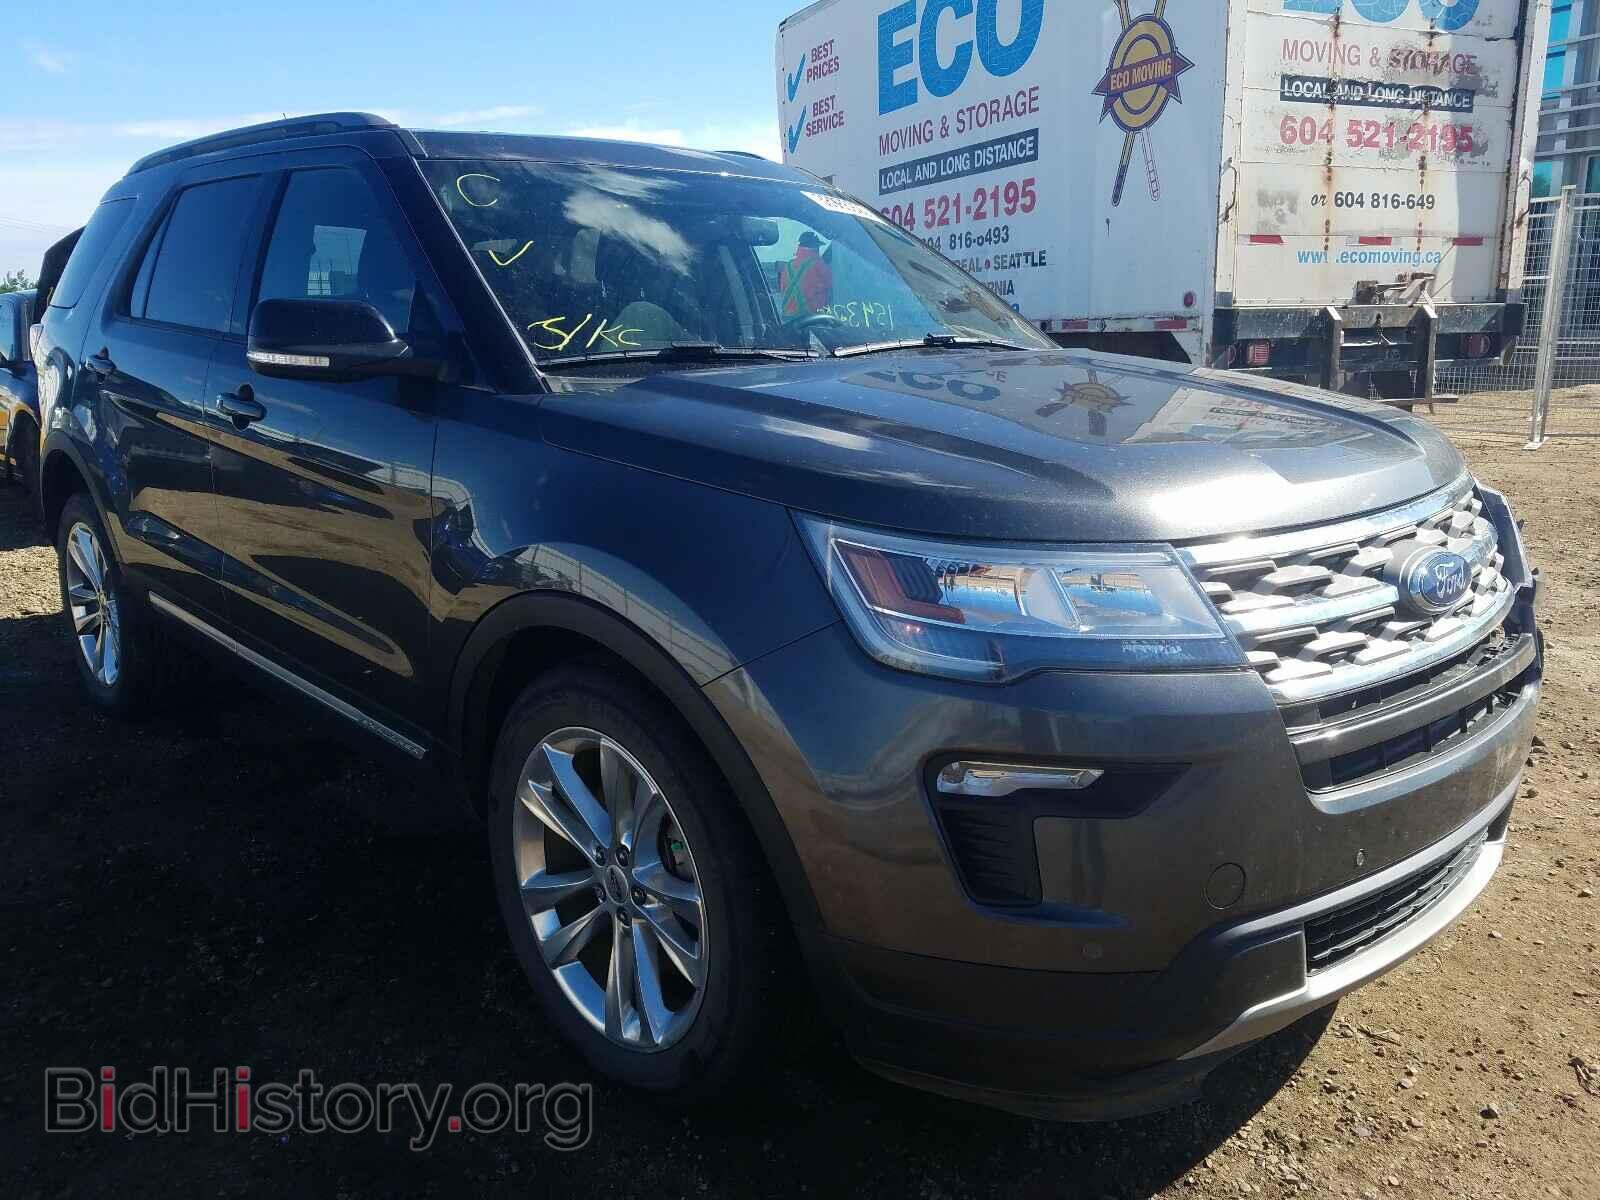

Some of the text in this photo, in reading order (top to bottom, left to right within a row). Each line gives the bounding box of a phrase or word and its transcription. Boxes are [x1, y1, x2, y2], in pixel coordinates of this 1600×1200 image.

[811, 39, 834, 63] BEST
[878, 0, 1044, 116] ECO
[1282, 38, 1477, 75] MOVING & STORAGE
[806, 56, 840, 83] PRICES
[1111, 58, 1172, 91] ECO MOVING
[813, 95, 836, 117] BEST
[1283, 79, 1471, 108] LOCAL AND LONG DISTANCE
[806, 111, 845, 137] SERVICE
[880, 86, 1039, 156] MOVING & STORAGE
[1280, 116, 1473, 152] 604 521-2195
[881, 136, 1035, 190] LOCAL AND LONG DISTANCE
[924, 177, 1036, 229] 521-2195
[1311, 192, 1436, 210] or 604 816-649
[994, 250, 1047, 270] SEATTLE
[1435, 561, 1467, 599] Ford
